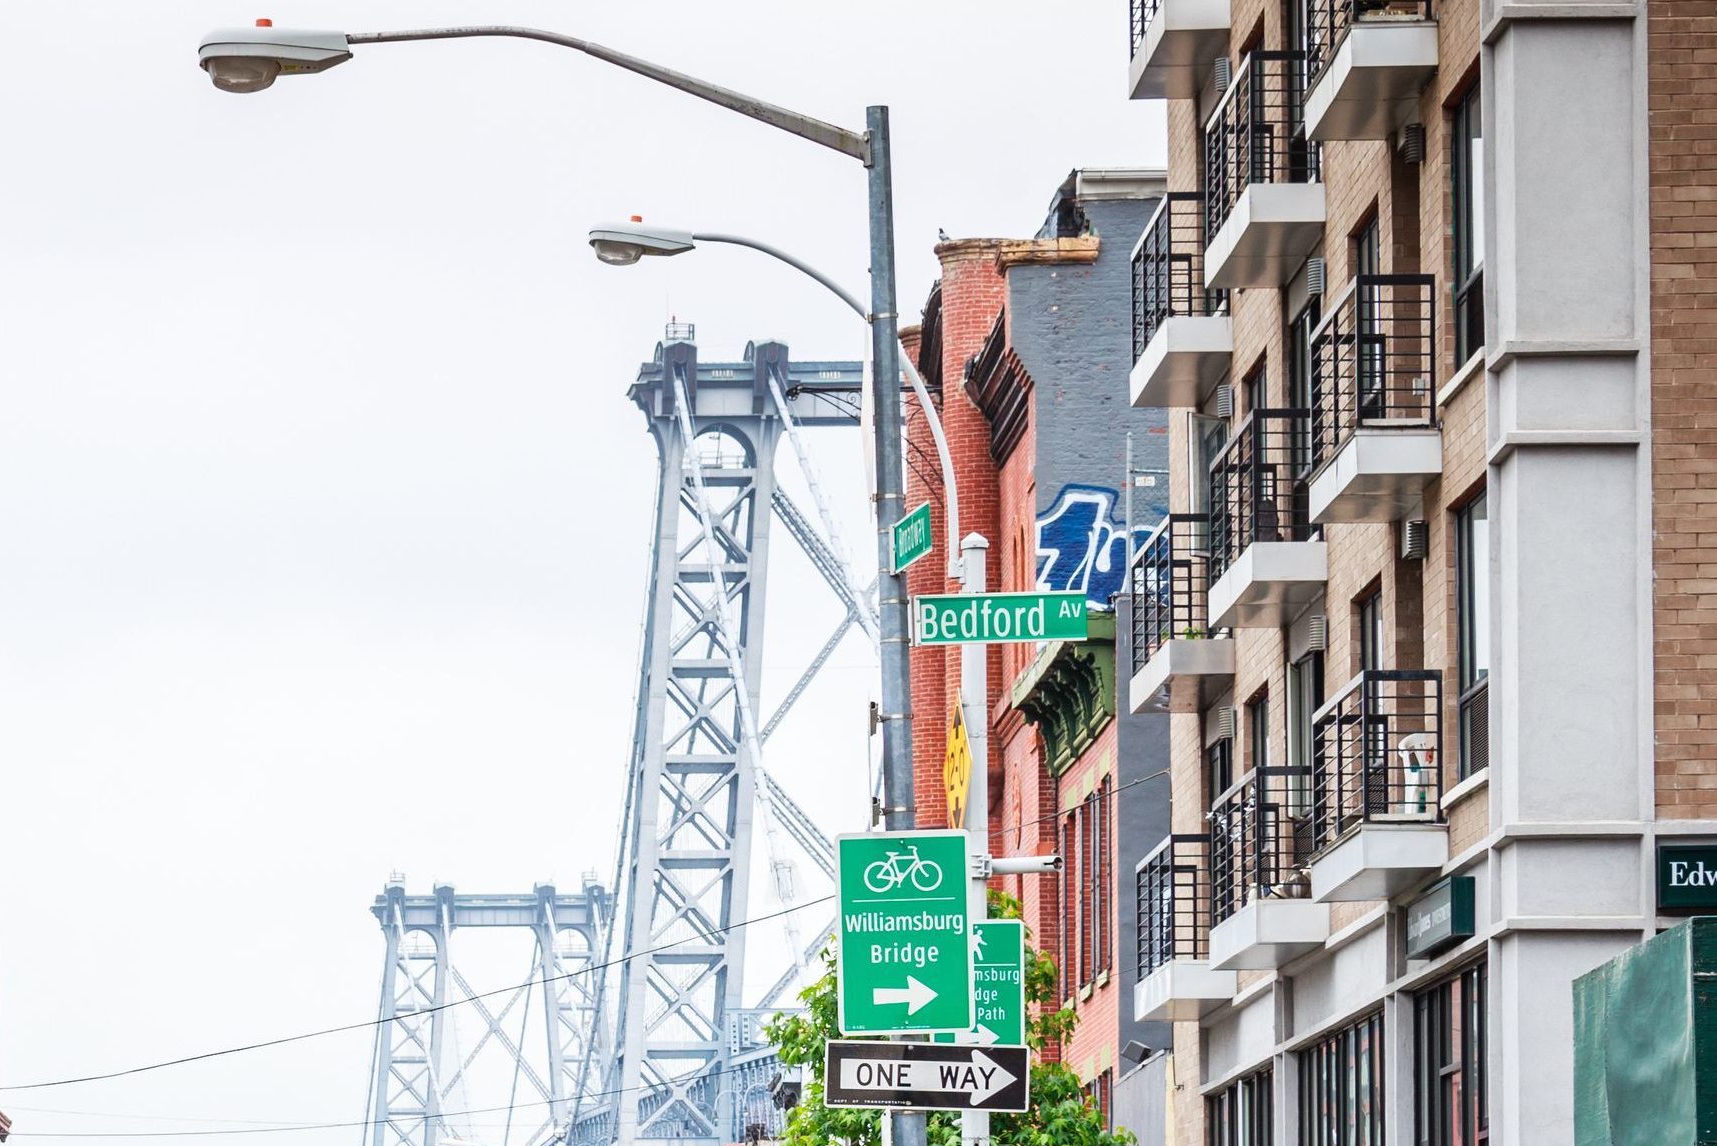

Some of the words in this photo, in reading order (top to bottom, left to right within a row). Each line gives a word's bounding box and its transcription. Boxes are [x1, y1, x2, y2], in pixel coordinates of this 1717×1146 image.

[920, 598, 1045, 639] Bedford
[1058, 600, 1082, 618] Av
[844, 910, 964, 935] Williamsburg
[870, 942, 939, 968] Bridge
[974, 969, 1020, 985] msburg
[974, 988, 998, 1005] dge
[977, 1007, 1006, 1021] Path
[856, 1062, 912, 1087] ONE
[939, 1065, 997, 1090] WAY
